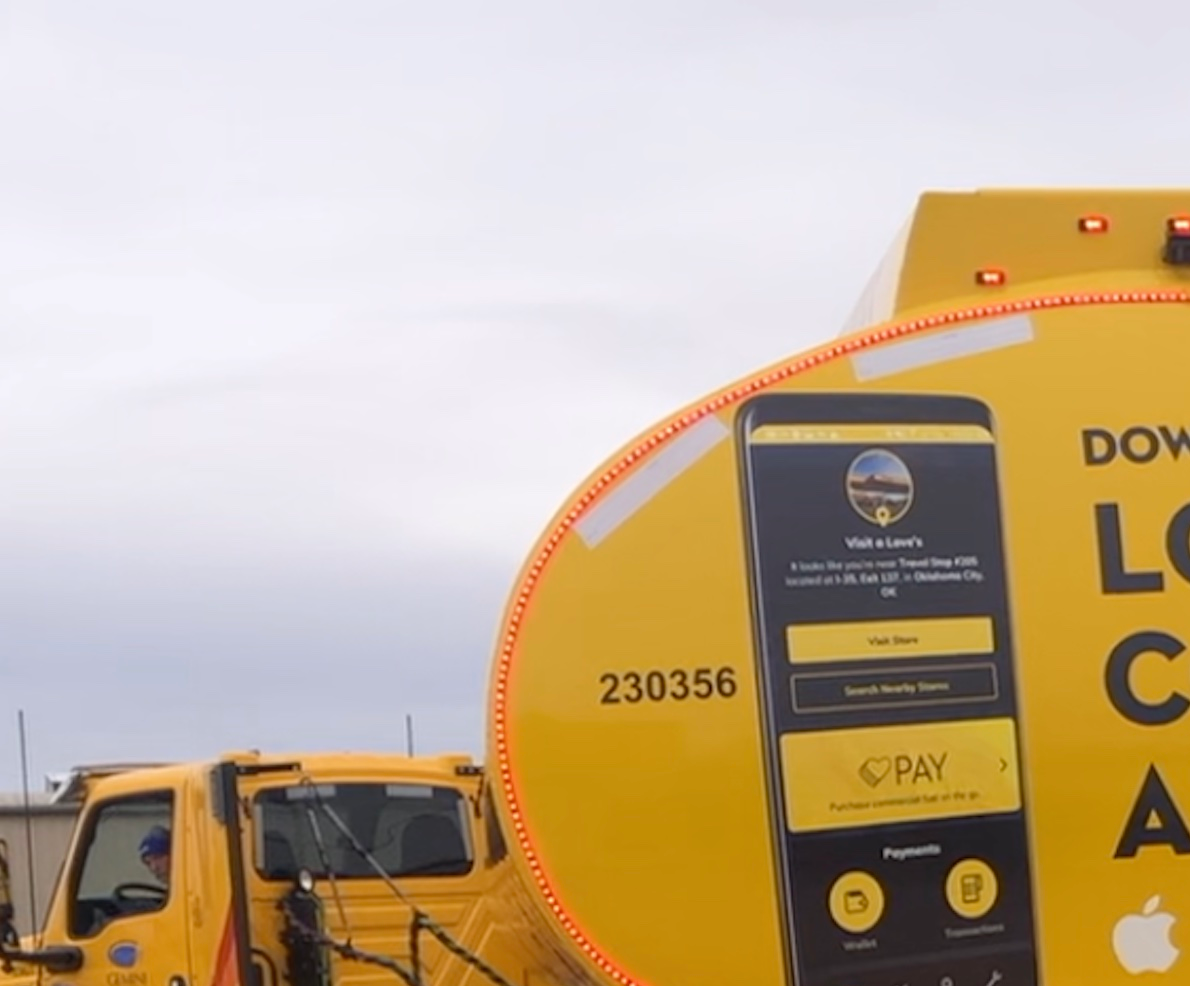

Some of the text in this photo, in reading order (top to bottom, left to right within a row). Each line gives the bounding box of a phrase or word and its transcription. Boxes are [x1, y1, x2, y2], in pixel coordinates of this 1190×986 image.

[844, 536, 873, 549] Visit
[598, 666, 737, 705] 230356
[895, 752, 948, 786] PAY
[882, 842, 941, 861] Payments
